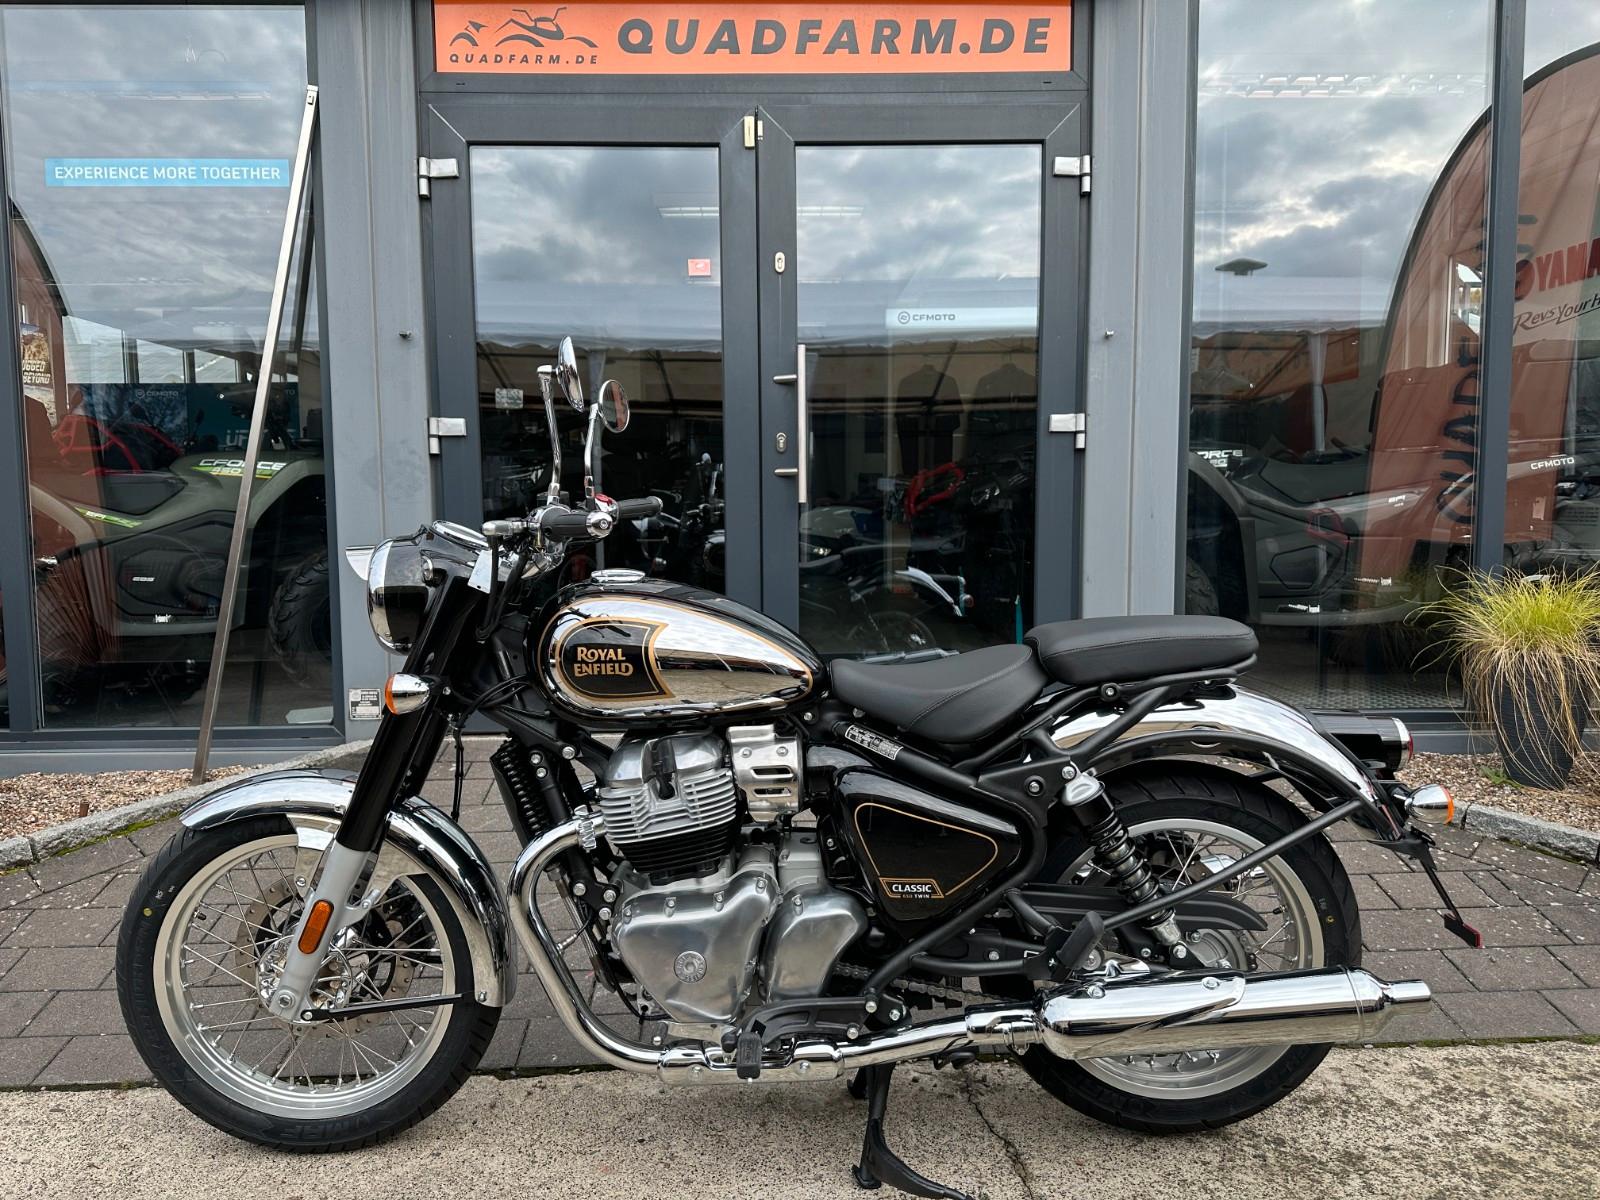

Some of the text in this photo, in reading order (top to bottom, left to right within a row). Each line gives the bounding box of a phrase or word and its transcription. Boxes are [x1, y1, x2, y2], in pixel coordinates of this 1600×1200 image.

[616, 18, 1051, 55] QUADFARM.DE
[449, 53, 598, 65] QUADFARM.DE
[54, 166, 281, 180] EXPERIENCE MORE TOGETHER
[1535, 237, 1600, 291] YAMA
[912, 313, 956, 322] CFMOTO
[1196, 449, 1244, 459] ORCE
[199, 458, 288, 471] CFOCE
[1530, 457, 1575, 470] CFMOTO
[577, 646, 626, 663] ROYAL
[573, 662, 634, 677] ENFIELD
[892, 884, 932, 893] CLASSIC
